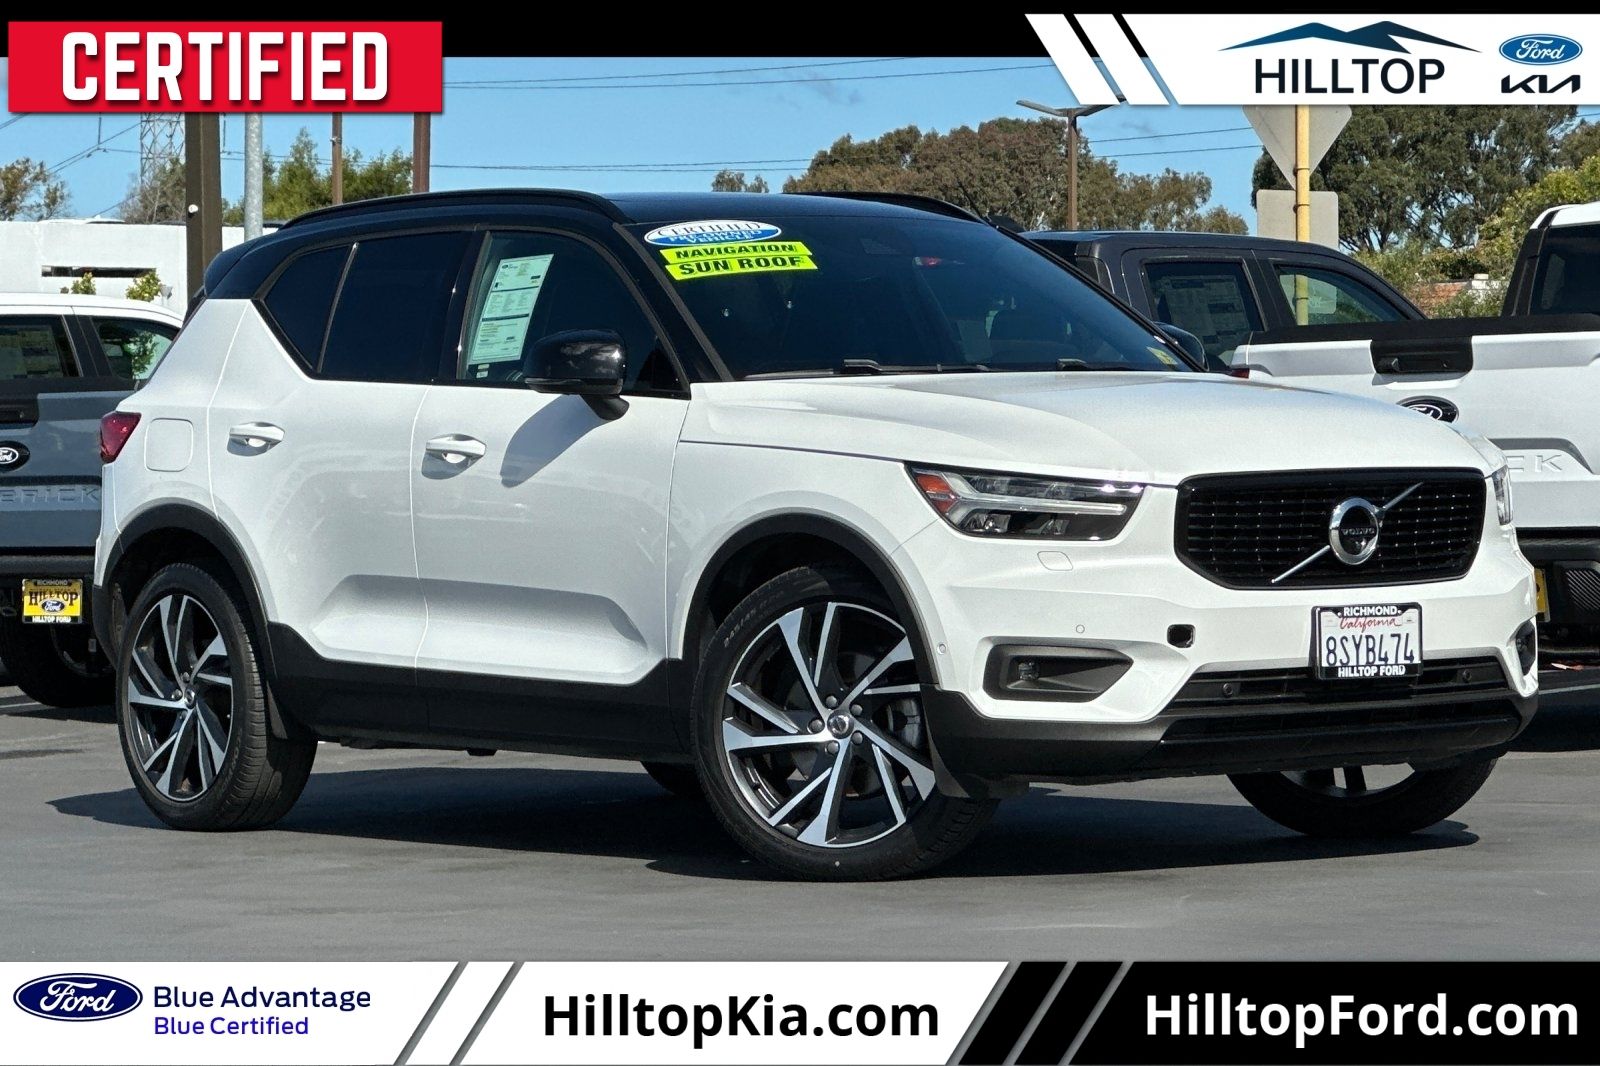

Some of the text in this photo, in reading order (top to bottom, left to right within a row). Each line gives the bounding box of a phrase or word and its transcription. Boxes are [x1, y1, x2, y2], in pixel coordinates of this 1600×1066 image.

[657, 221, 761, 237] CERTIFIED
[676, 244, 794, 259] NAVIGATION
[678, 256, 802, 275] SUN ROOF
[1341, 527, 1375, 536] VOLVO
[28, 590, 79, 606] HILLTOP
[1343, 606, 1397, 617] RICHMOND
[1340, 617, 1403, 633] California
[1326, 633, 1415, 666] 8SYB474
[1337, 665, 1406, 678] HILLTOP FORD
